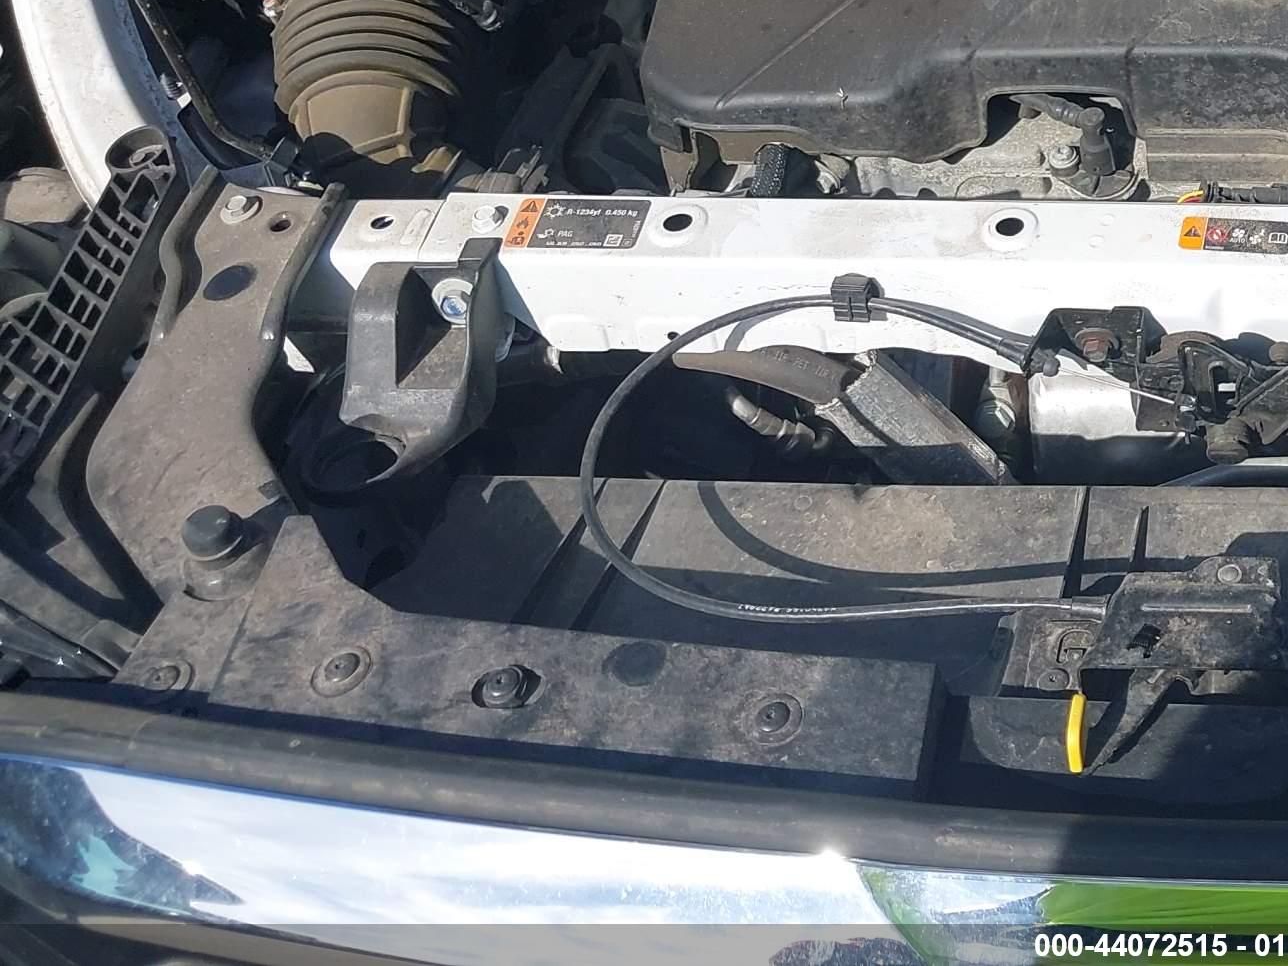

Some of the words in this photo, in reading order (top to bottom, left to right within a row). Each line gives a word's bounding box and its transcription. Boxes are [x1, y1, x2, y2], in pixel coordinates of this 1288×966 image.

[566, 208, 602, 218] R-1234yf
[605, 208, 627, 216] 0.450
[627, 209, 639, 218] kg
[557, 229, 574, 237] PAG
